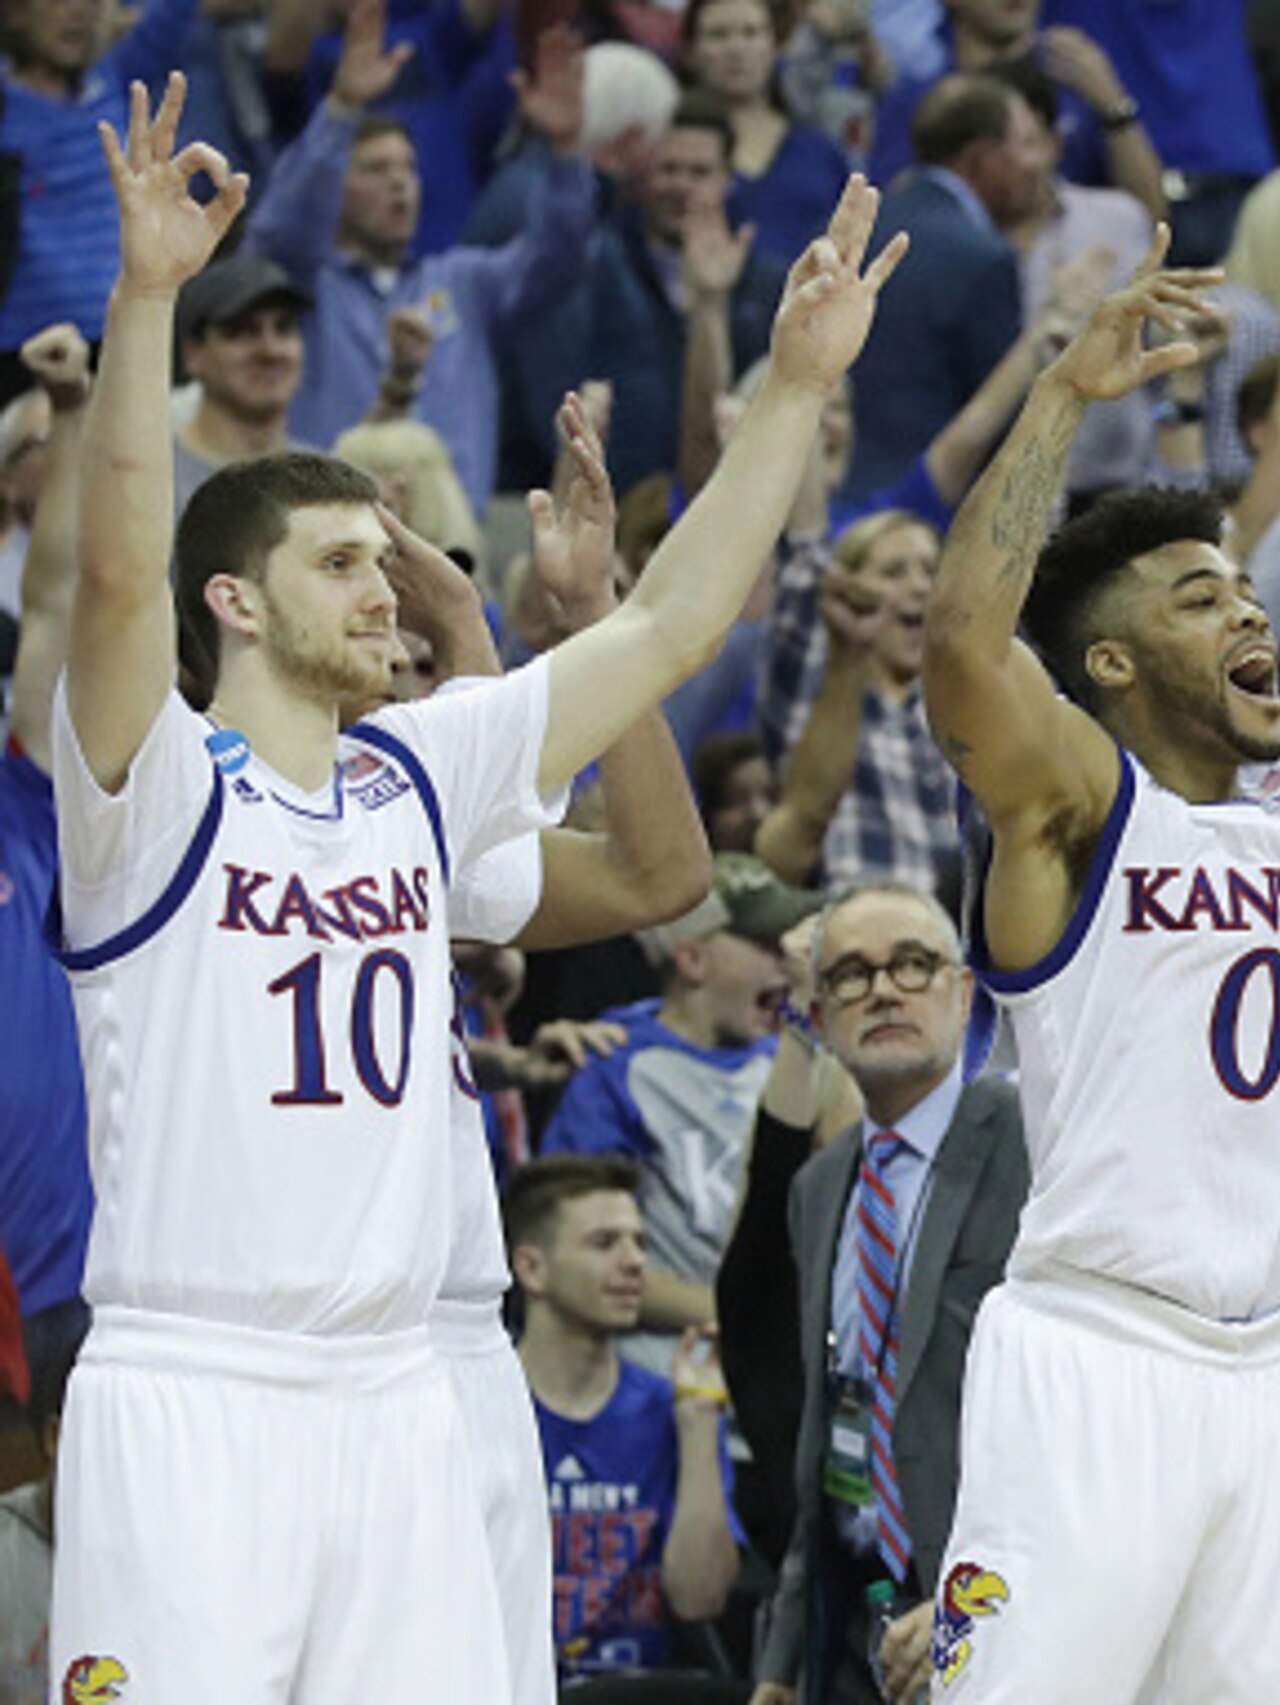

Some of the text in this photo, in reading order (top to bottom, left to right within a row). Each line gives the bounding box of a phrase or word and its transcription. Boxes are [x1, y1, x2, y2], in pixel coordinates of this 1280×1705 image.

[217, 862, 428, 944] KANSAS
[267, 948, 415, 1108] 10
[553, 1508, 658, 1576] EET
